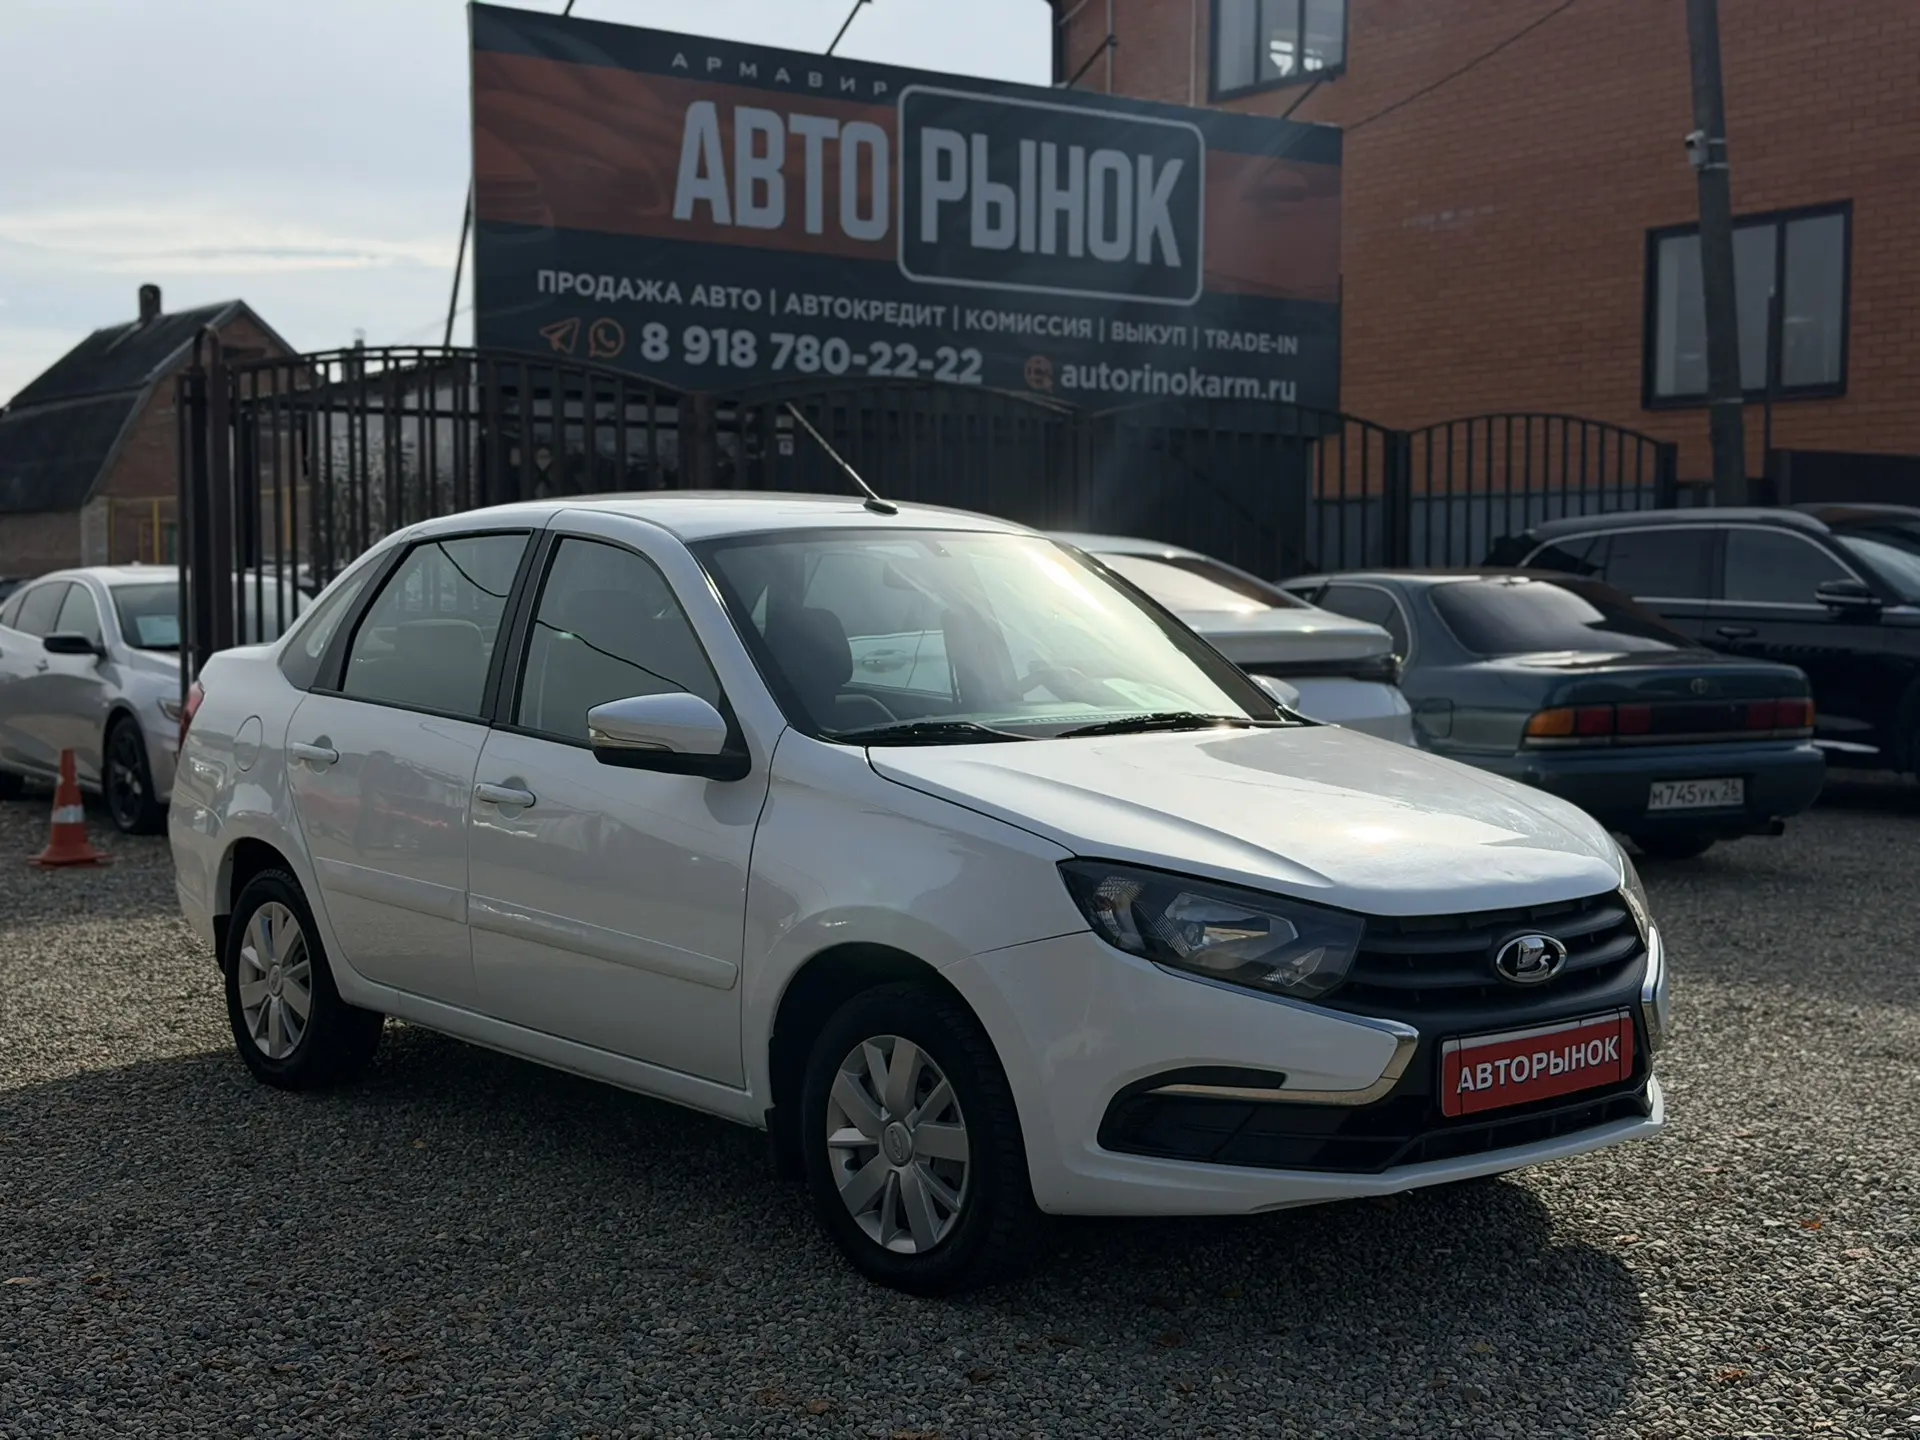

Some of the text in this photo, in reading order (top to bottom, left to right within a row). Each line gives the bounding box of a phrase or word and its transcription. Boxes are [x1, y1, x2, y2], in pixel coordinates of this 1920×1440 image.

[672, 52, 888, 96] АРМАВИР
[672, 99, 1185, 268] АВТО РЫНОК
[536, 269, 1299, 355] ПРОДАЖА АВТО АВТОКРЕДИТ КОМИССИЯ ВЫКУП TRADE-IN
[640, 321, 983, 385] 8 918 780-22-22
[1059, 360, 1297, 403] autorinokarm.ru
[1456, 1035, 1620, 1095] АВТОРЫНОК
